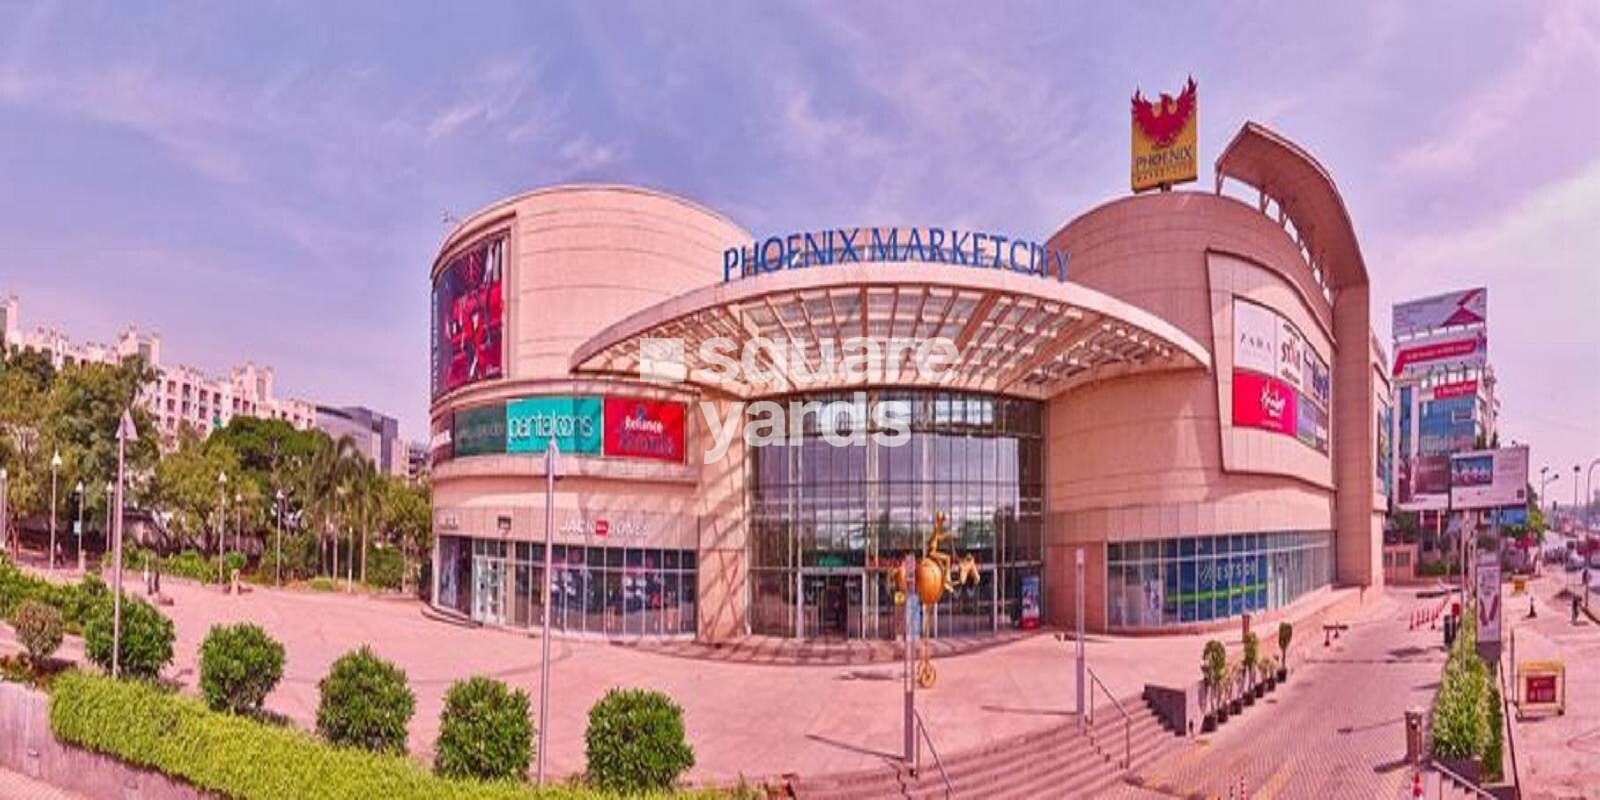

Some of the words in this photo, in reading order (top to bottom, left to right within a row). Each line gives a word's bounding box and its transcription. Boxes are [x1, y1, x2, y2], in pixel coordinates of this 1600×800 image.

[1136, 145, 1192, 169] PHOENIX
[723, 228, 859, 282] PHOENIX
[509, 410, 593, 443] pantaloons
[624, 415, 664, 433] Reliance
